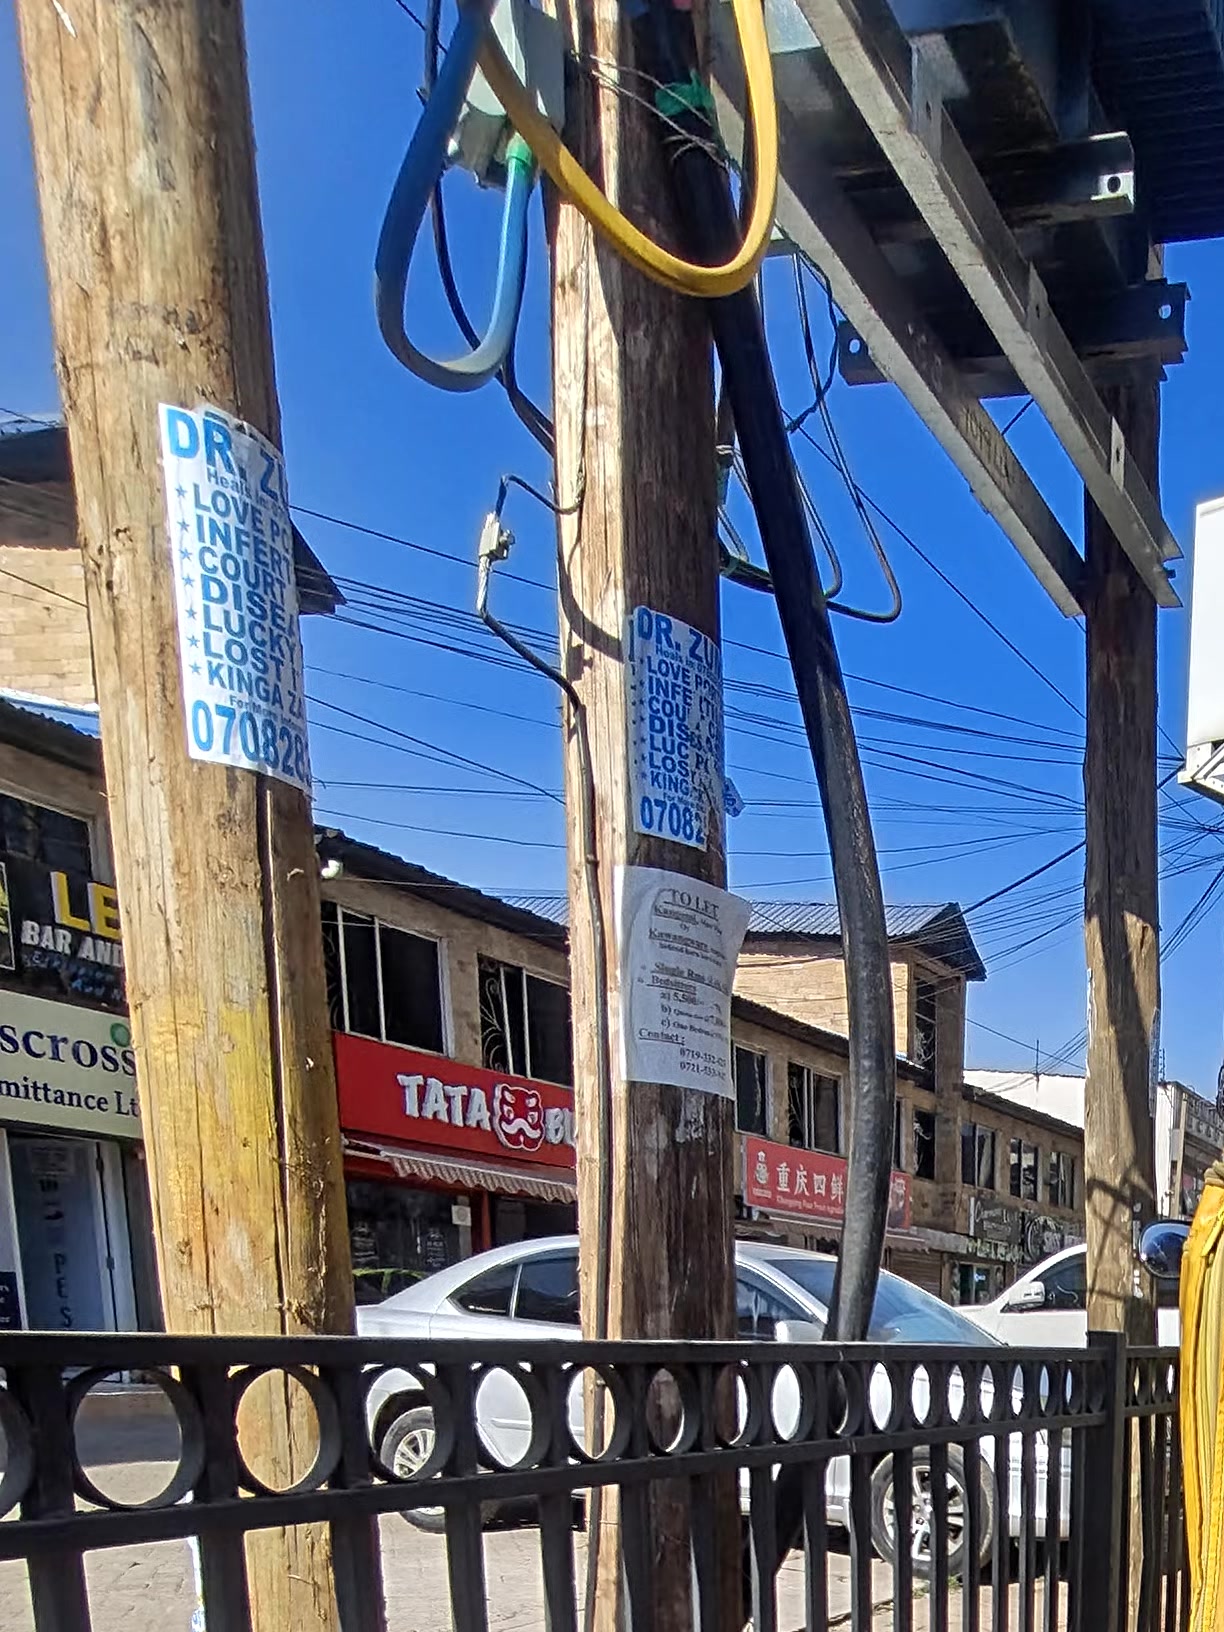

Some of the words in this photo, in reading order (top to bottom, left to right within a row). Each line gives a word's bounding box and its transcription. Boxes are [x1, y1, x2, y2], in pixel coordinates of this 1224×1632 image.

[166, 407, 248, 482] DR.
[193, 483, 264, 536] LOVE
[199, 546, 286, 606] COURT
[203, 603, 296, 666] LUCKY
[638, 607, 681, 652] DR.
[203, 631, 284, 682] LOST
[647, 655, 691, 686] LOVE
[207, 660, 284, 712] KINGA
[667, 889, 691, 906] TO
[695, 896, 719, 919] LET
[20, 919, 72, 957] BAR
[396, 1074, 492, 1132] TATA
